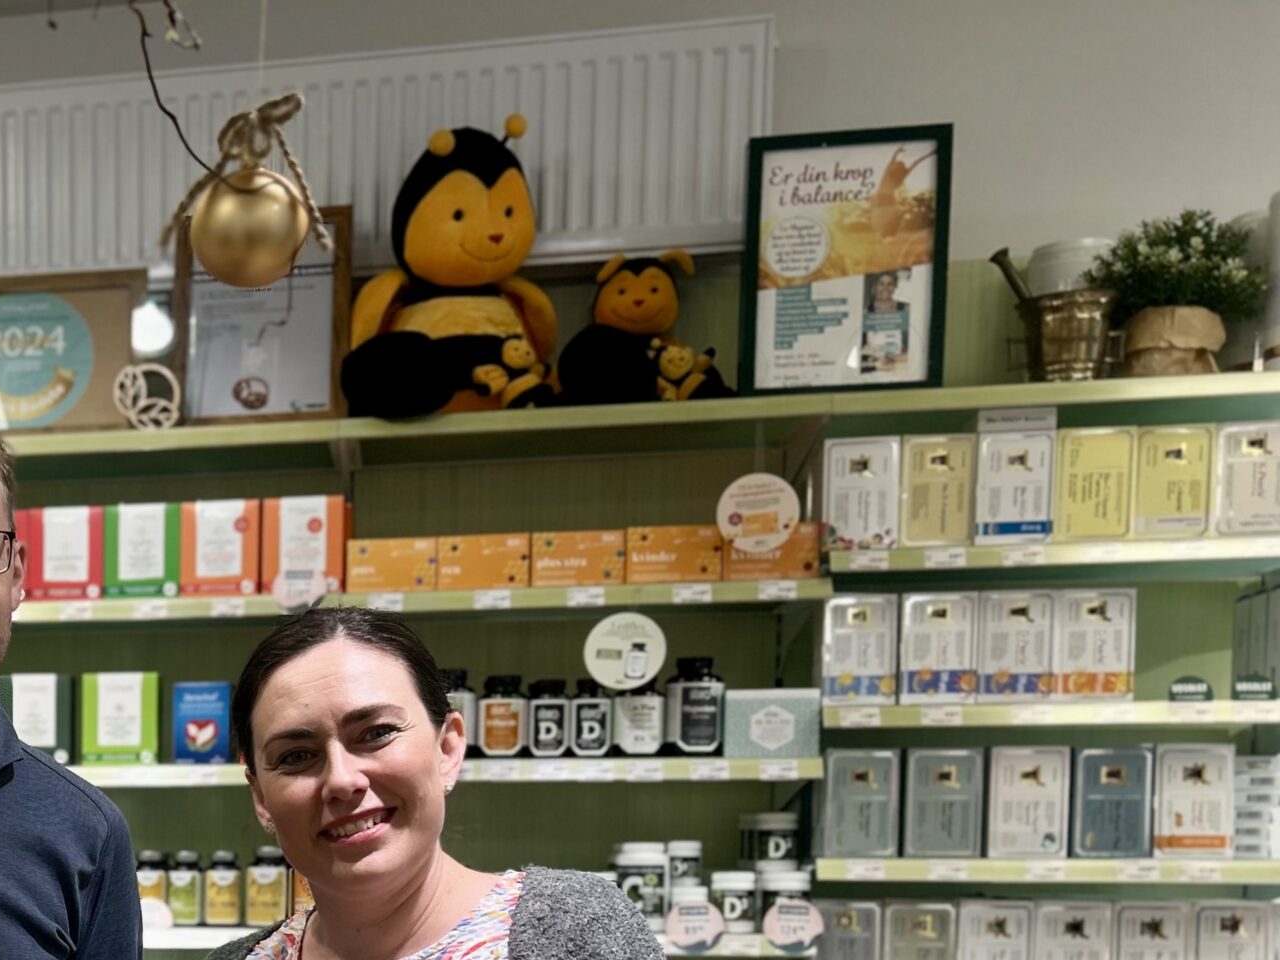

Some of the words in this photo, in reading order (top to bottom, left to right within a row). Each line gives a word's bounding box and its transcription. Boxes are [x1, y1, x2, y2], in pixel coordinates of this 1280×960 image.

[769, 165, 794, 186] Er
[796, 163, 828, 183] din
[833, 161, 874, 185] krop
[779, 189, 787, 206] i
[790, 181, 876, 206] balance?
